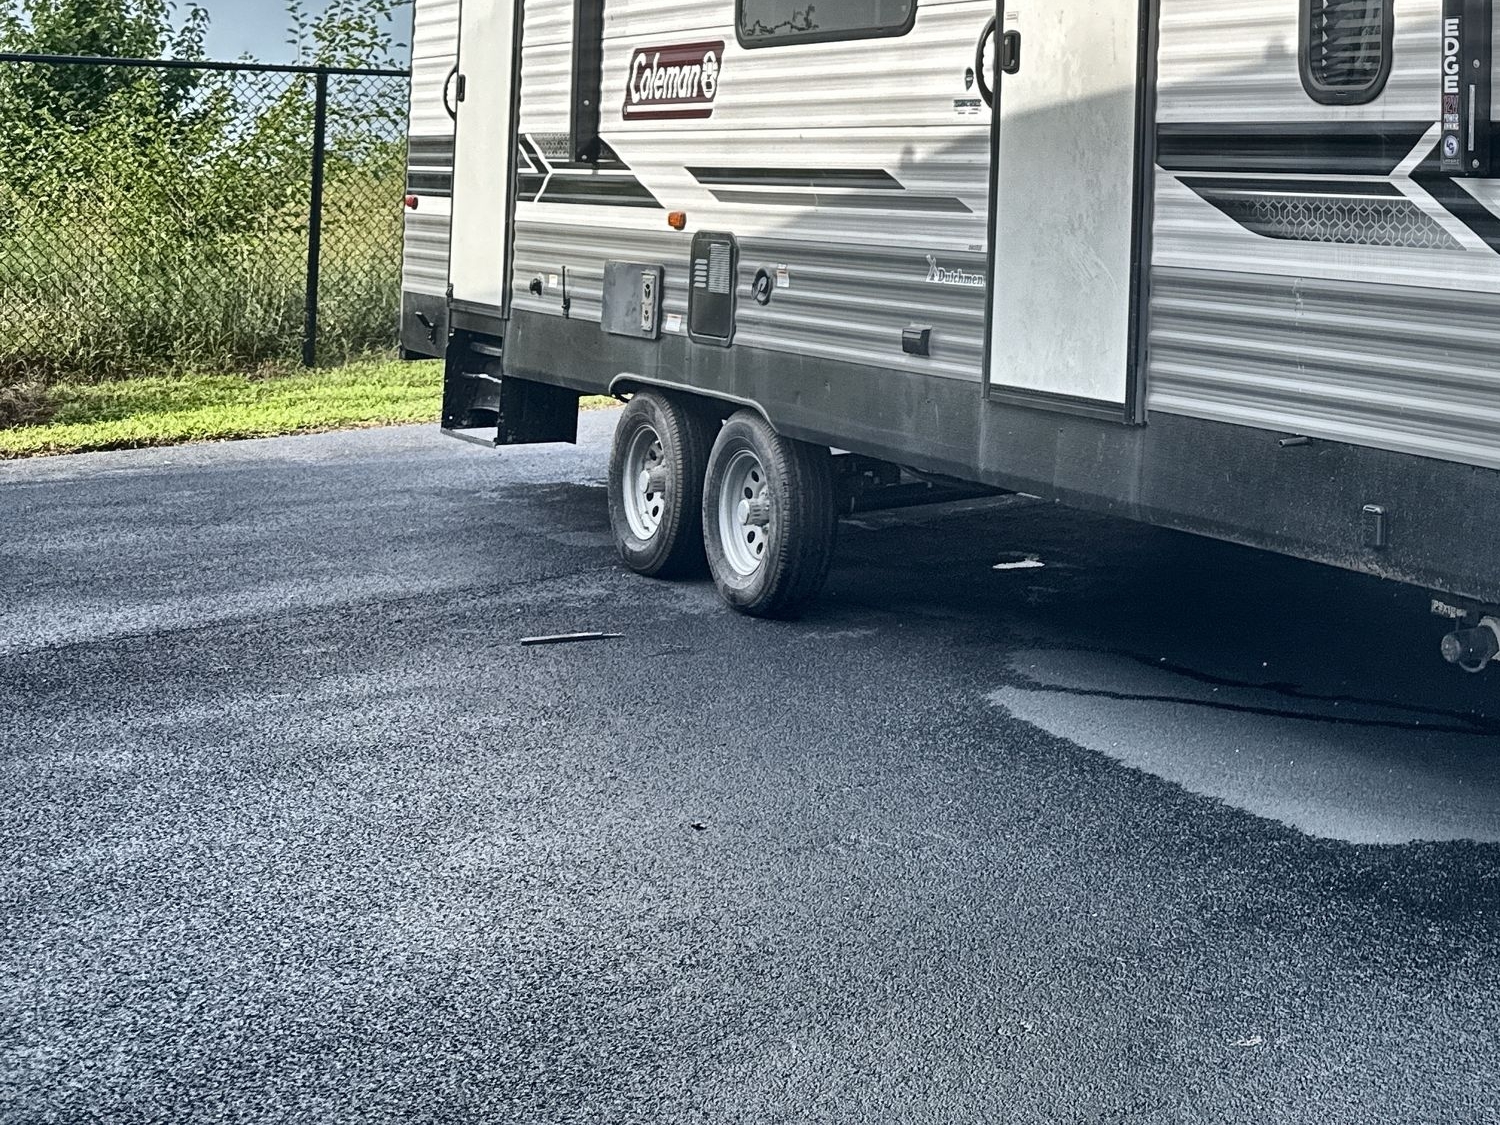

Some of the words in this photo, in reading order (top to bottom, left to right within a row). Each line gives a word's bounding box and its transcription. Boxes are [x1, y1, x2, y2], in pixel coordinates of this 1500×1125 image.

[630, 52, 701, 104] Coleman
[1443, 18, 1459, 93] EDGE
[938, 268, 983, 285] Dutchmen
